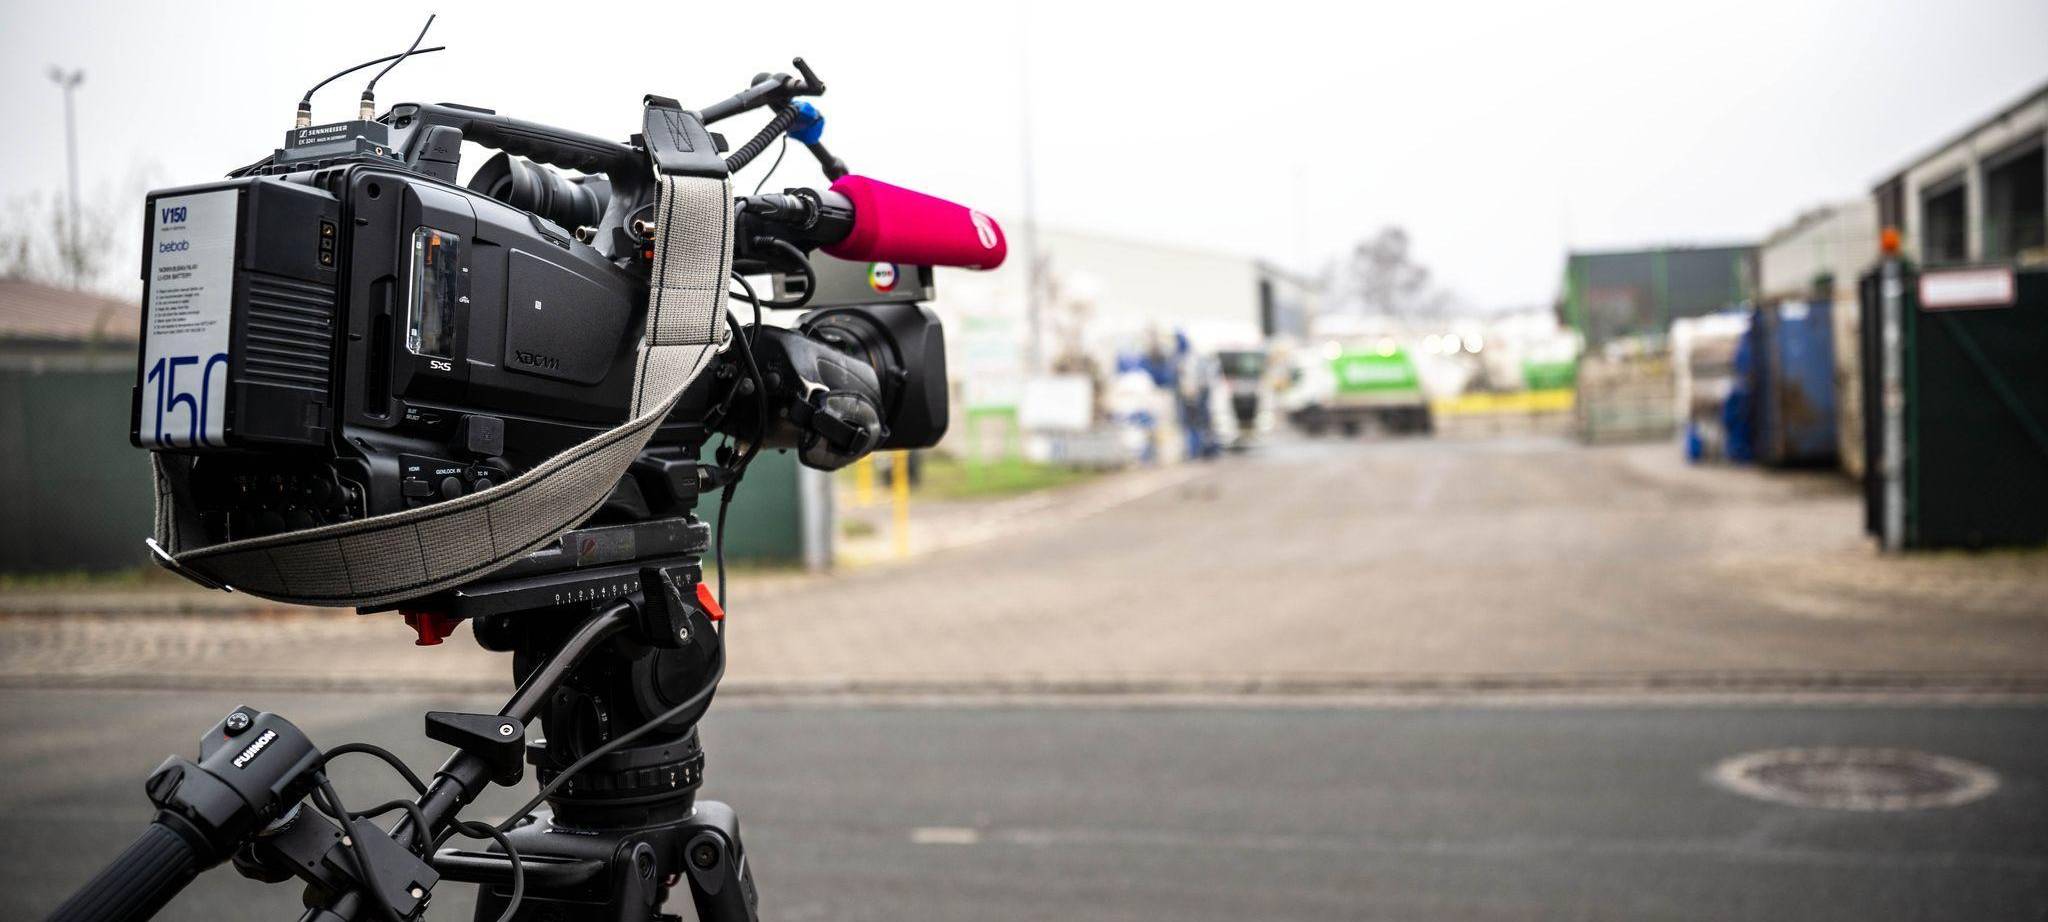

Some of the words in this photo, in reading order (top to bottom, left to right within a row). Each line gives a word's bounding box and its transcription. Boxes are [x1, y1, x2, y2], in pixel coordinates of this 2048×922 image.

[308, 125, 348, 136] SENNHEISER
[161, 206, 188, 224] V150
[159, 239, 190, 254] bebob
[233, 730, 277, 768] FUJINON
